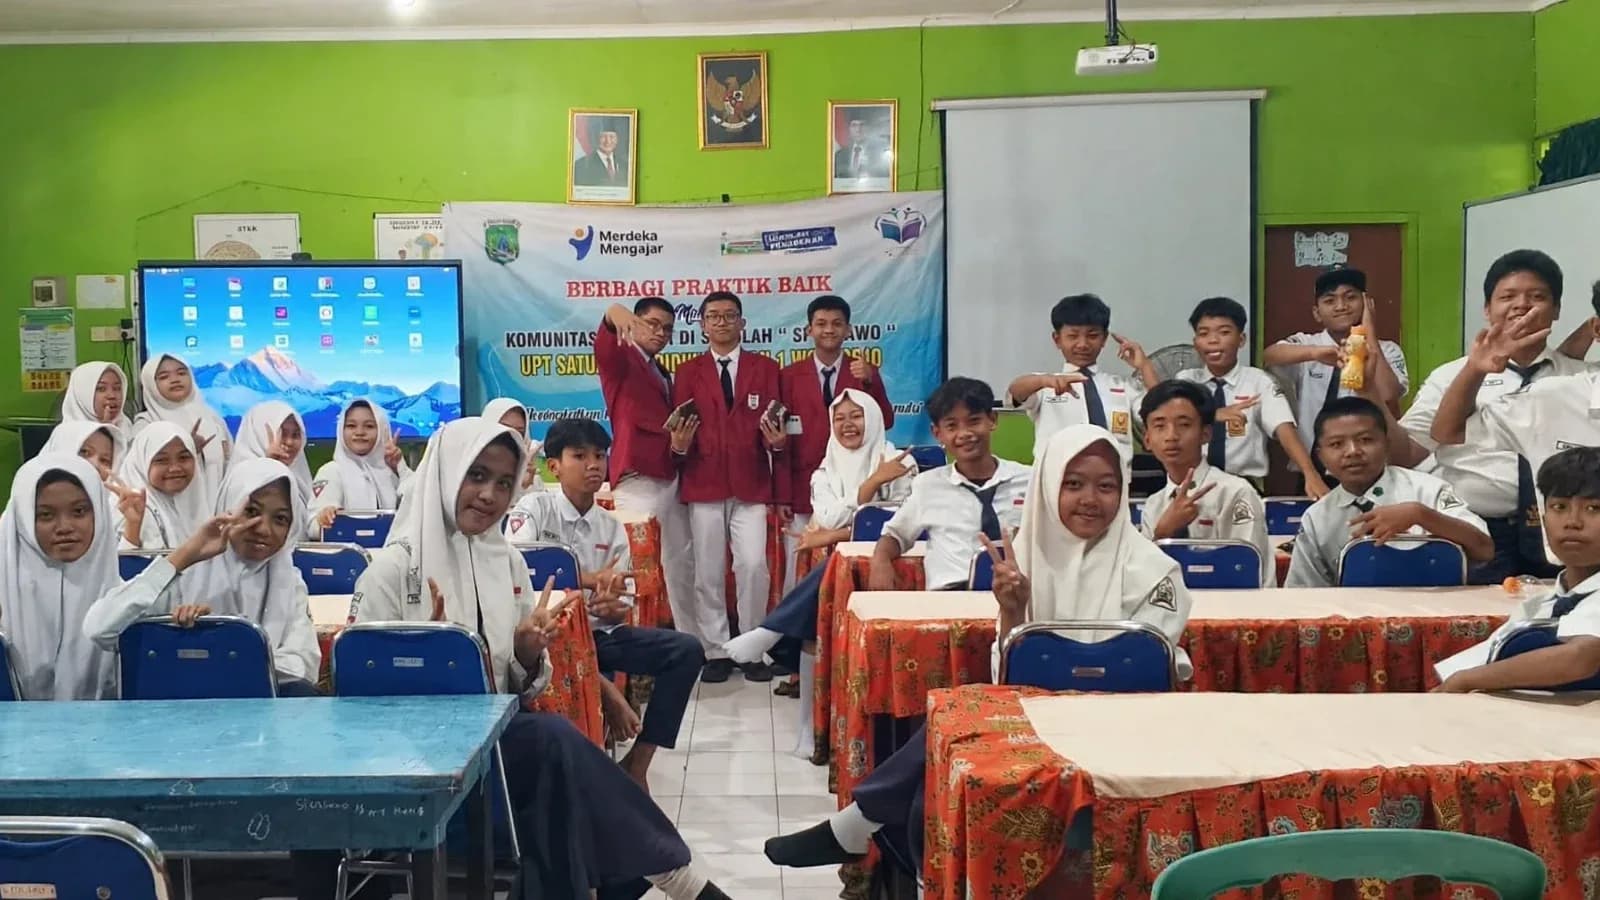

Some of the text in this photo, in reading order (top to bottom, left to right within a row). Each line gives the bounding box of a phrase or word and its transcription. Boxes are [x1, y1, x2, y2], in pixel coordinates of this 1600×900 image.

[600, 231, 658, 241] Merdeka
[600, 243, 664, 257] Mengajar
[567, 276, 832, 297] BERBAGI PRAKTIK BAIK
[506, 332, 597, 348] KOMUNITAS
[680, 331, 694, 345] DI
[520, 355, 551, 375] UPT
